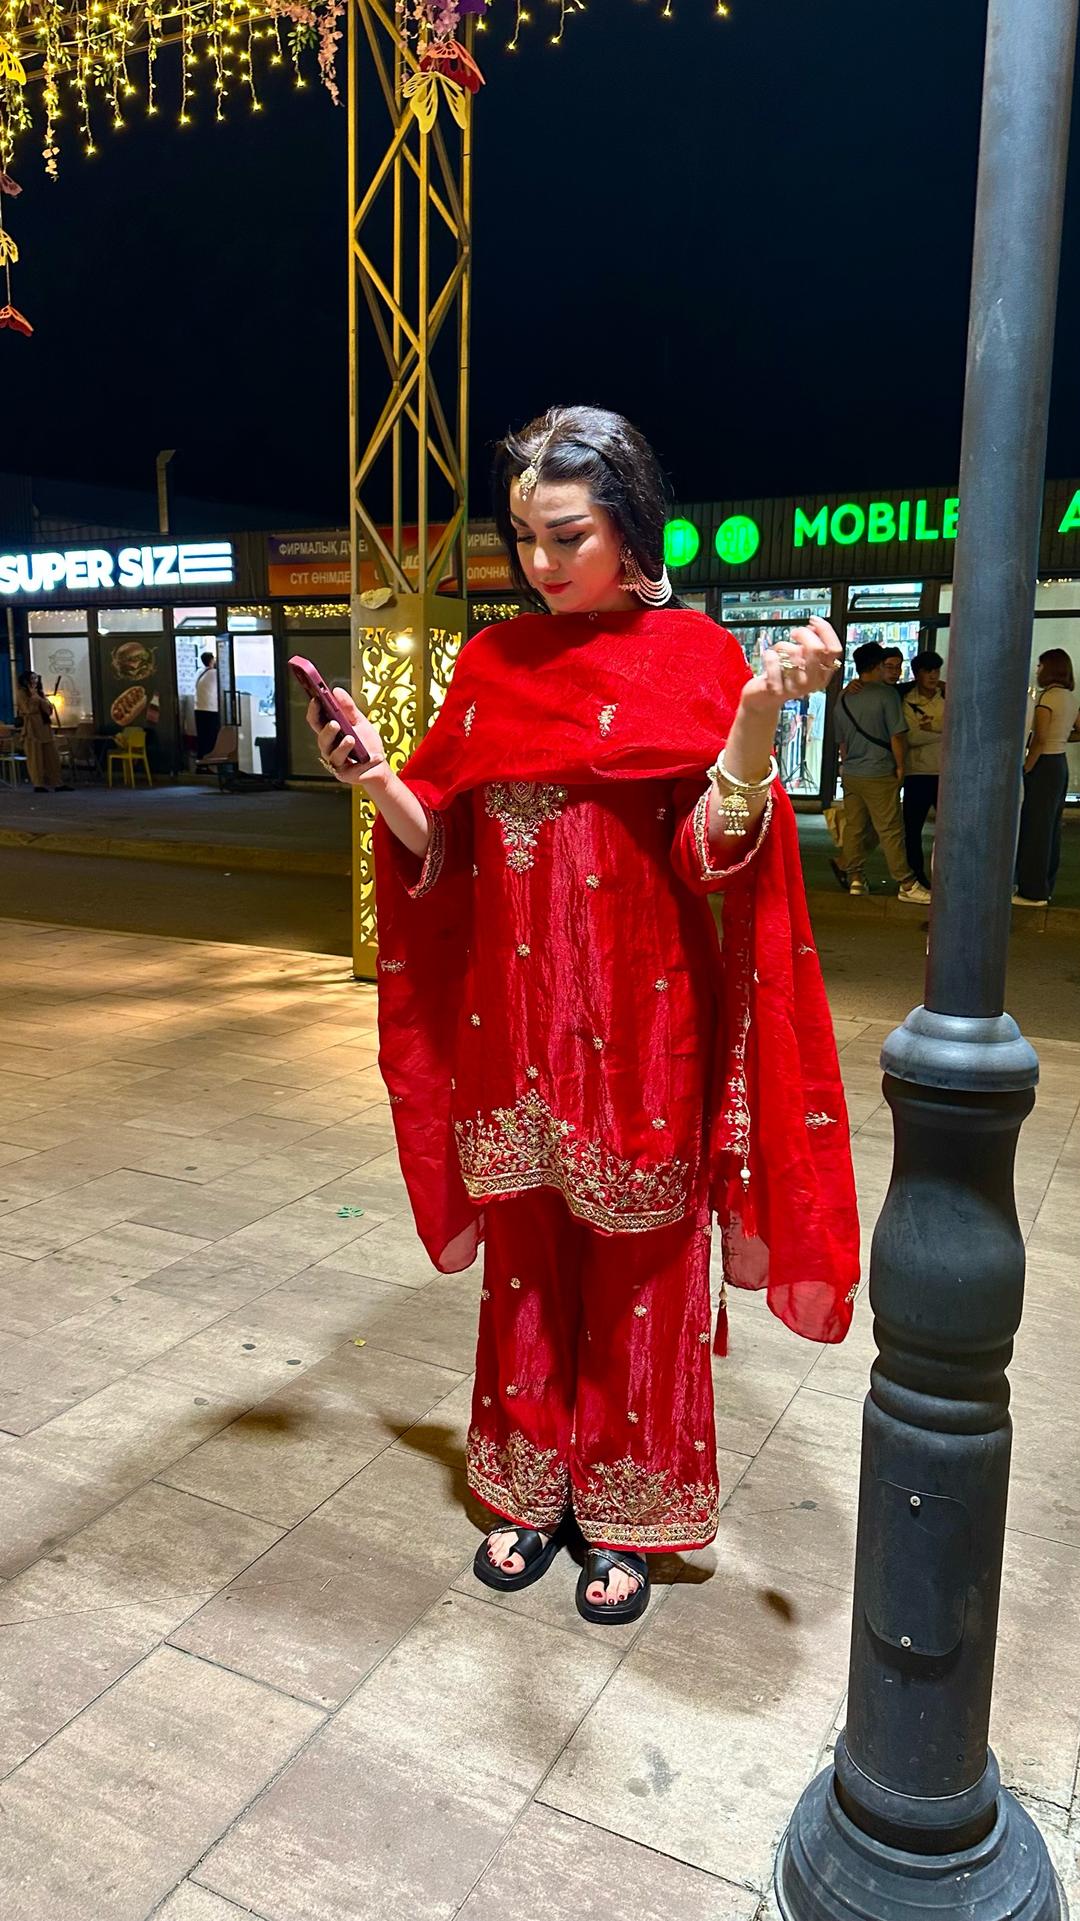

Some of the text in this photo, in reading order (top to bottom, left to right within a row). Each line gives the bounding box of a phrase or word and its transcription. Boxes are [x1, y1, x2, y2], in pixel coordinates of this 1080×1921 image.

[794, 498, 959, 547] MOBILE
[278, 541, 338, 556] ФИРМАЛЫҚ
[0, 542, 232, 594] SUPER SIZE
[466, 565, 511, 580] ОЛОЧНАЯ
